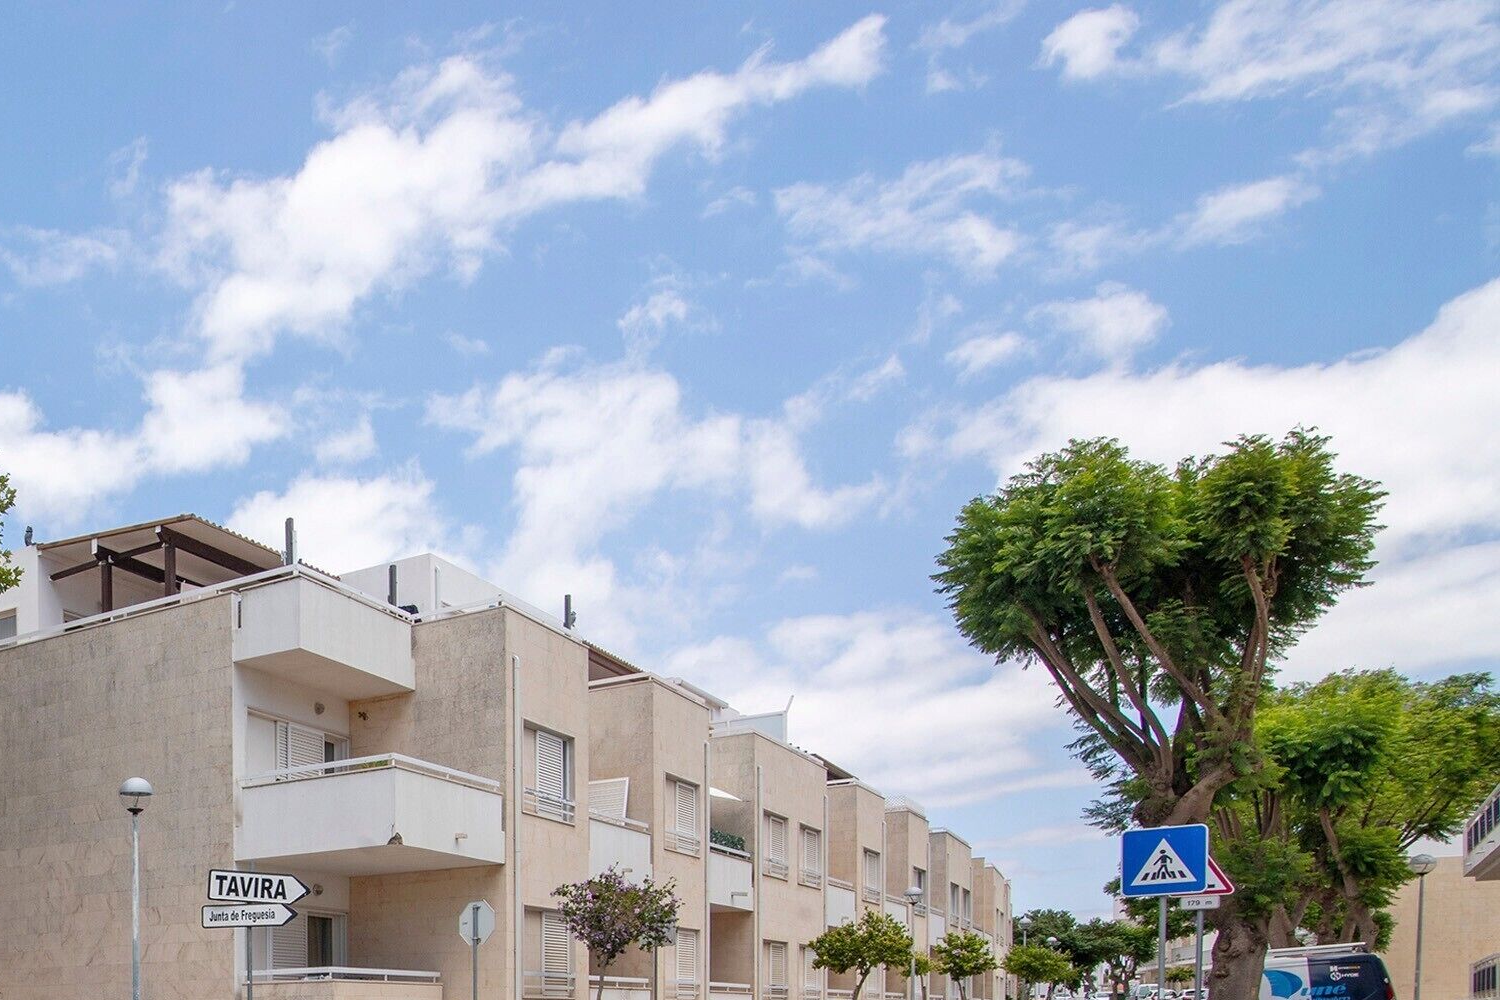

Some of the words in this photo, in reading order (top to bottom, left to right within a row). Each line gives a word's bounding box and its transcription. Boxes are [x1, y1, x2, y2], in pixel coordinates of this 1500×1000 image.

[215, 874, 287, 900] TAVIRA
[209, 911, 229, 922] Junta
[230, 910, 239, 921] de
[241, 908, 275, 923] Freguesia
